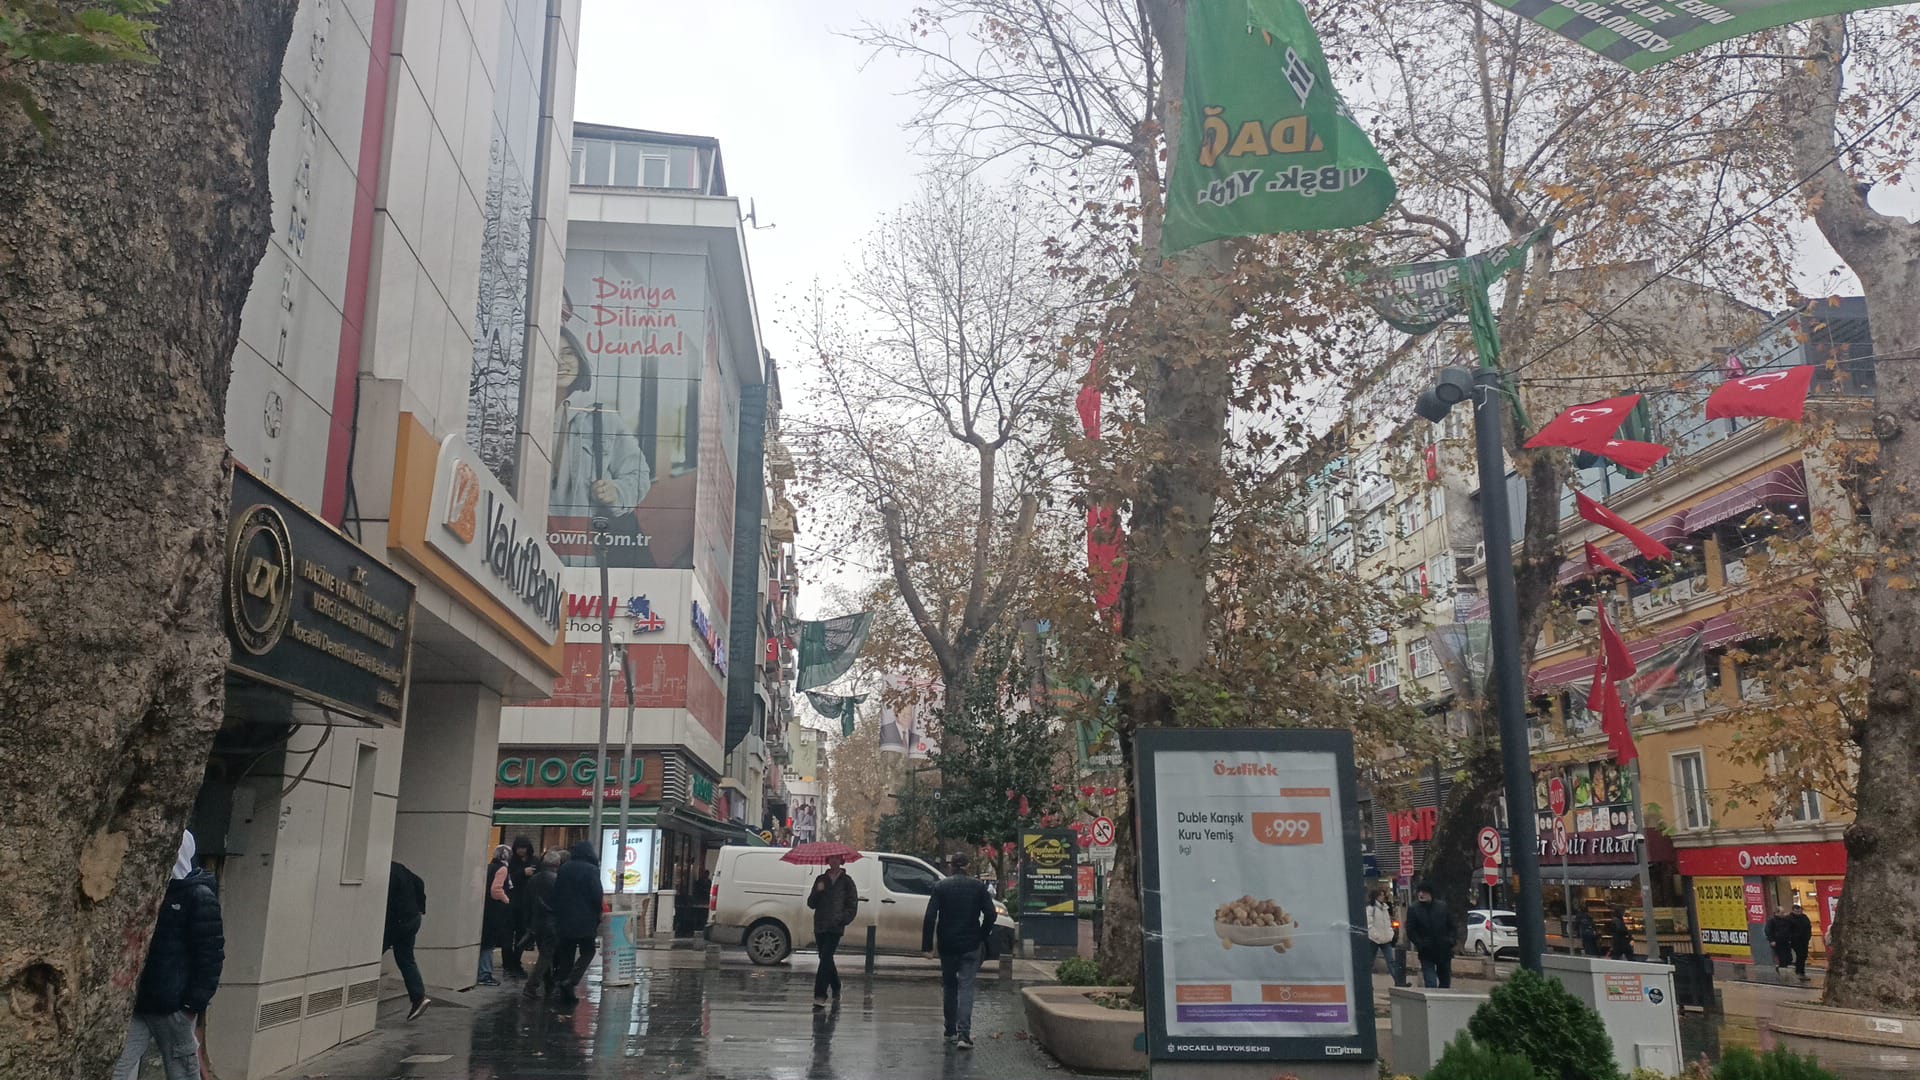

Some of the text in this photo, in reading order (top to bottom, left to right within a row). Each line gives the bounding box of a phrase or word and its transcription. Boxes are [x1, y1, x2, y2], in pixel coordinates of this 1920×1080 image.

[592, 276, 676, 308] Dünya
[590, 303, 676, 327] Dilimin
[586, 329, 684, 356] Ucunda!
[486, 490, 564, 631] VakıfBank
[1178, 811, 1244, 827] Duble Karışık
[1178, 829, 1234, 843] Kuru Yemiş
[1752, 852, 1798, 866] vodafone
